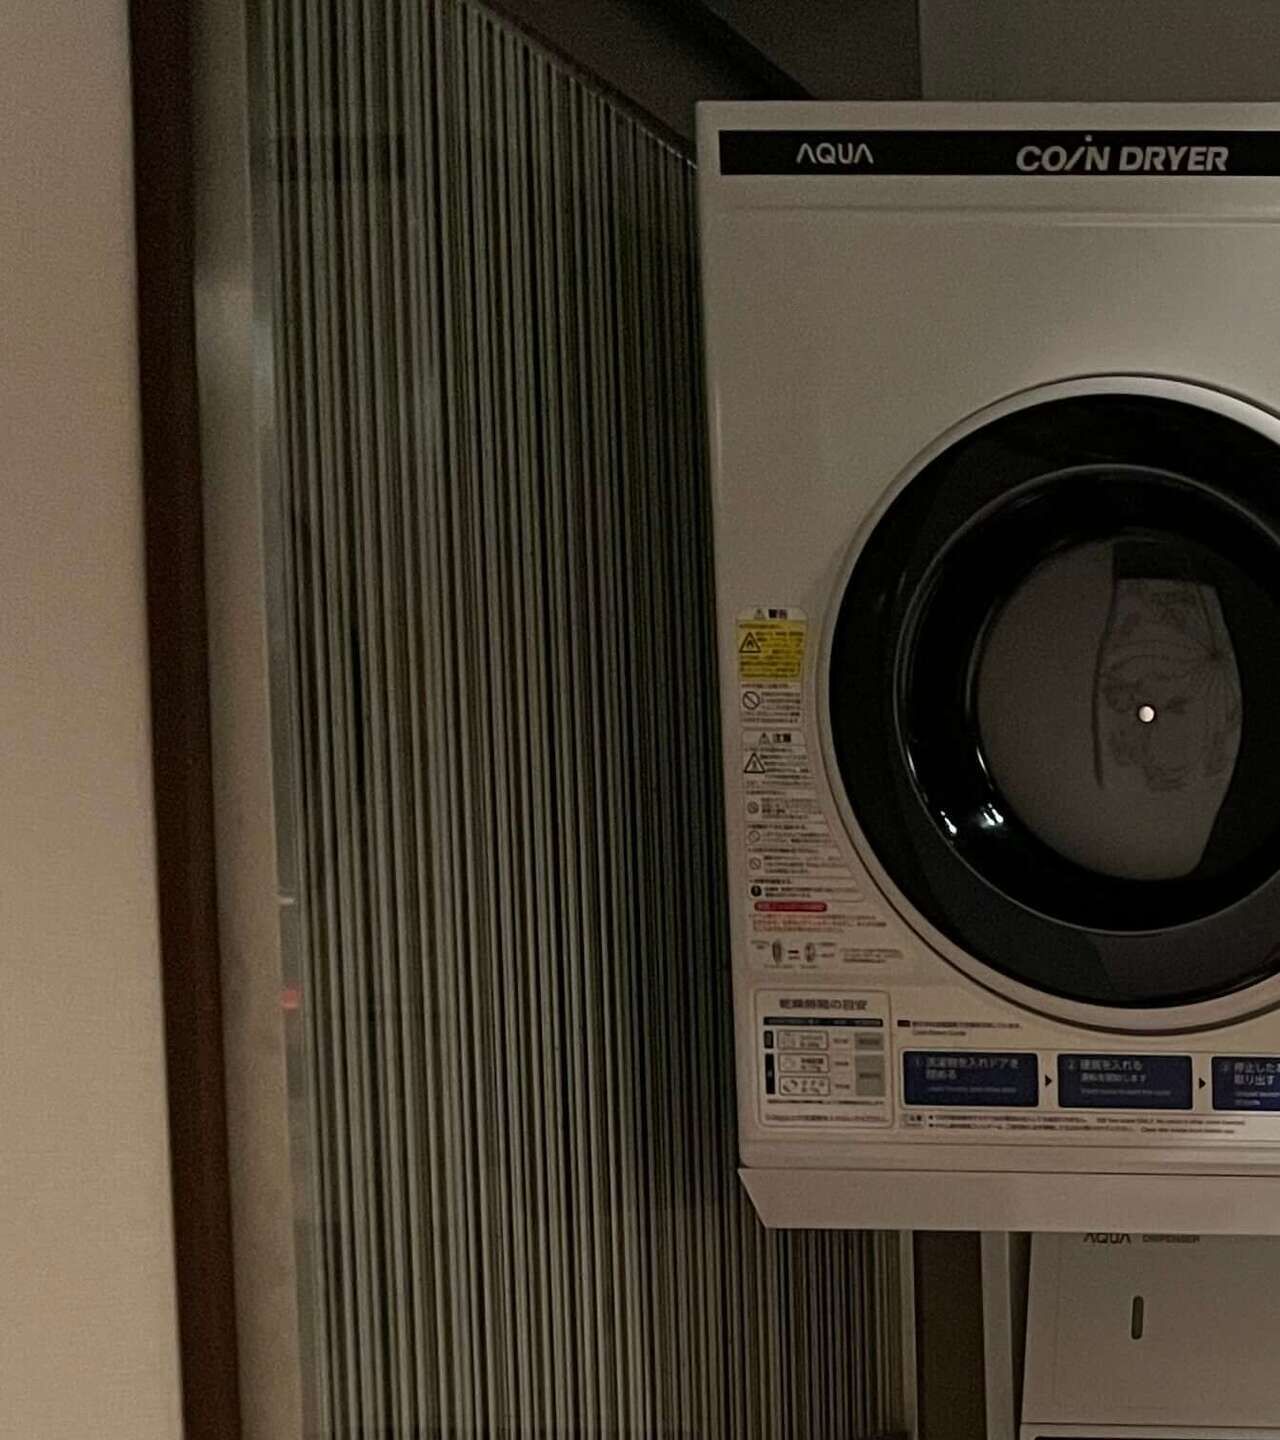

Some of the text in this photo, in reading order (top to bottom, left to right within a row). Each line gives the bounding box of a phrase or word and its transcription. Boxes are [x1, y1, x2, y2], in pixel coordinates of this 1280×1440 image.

[796, 142, 874, 166] AQUA
[1016, 134, 1230, 172] COIN DRYER
